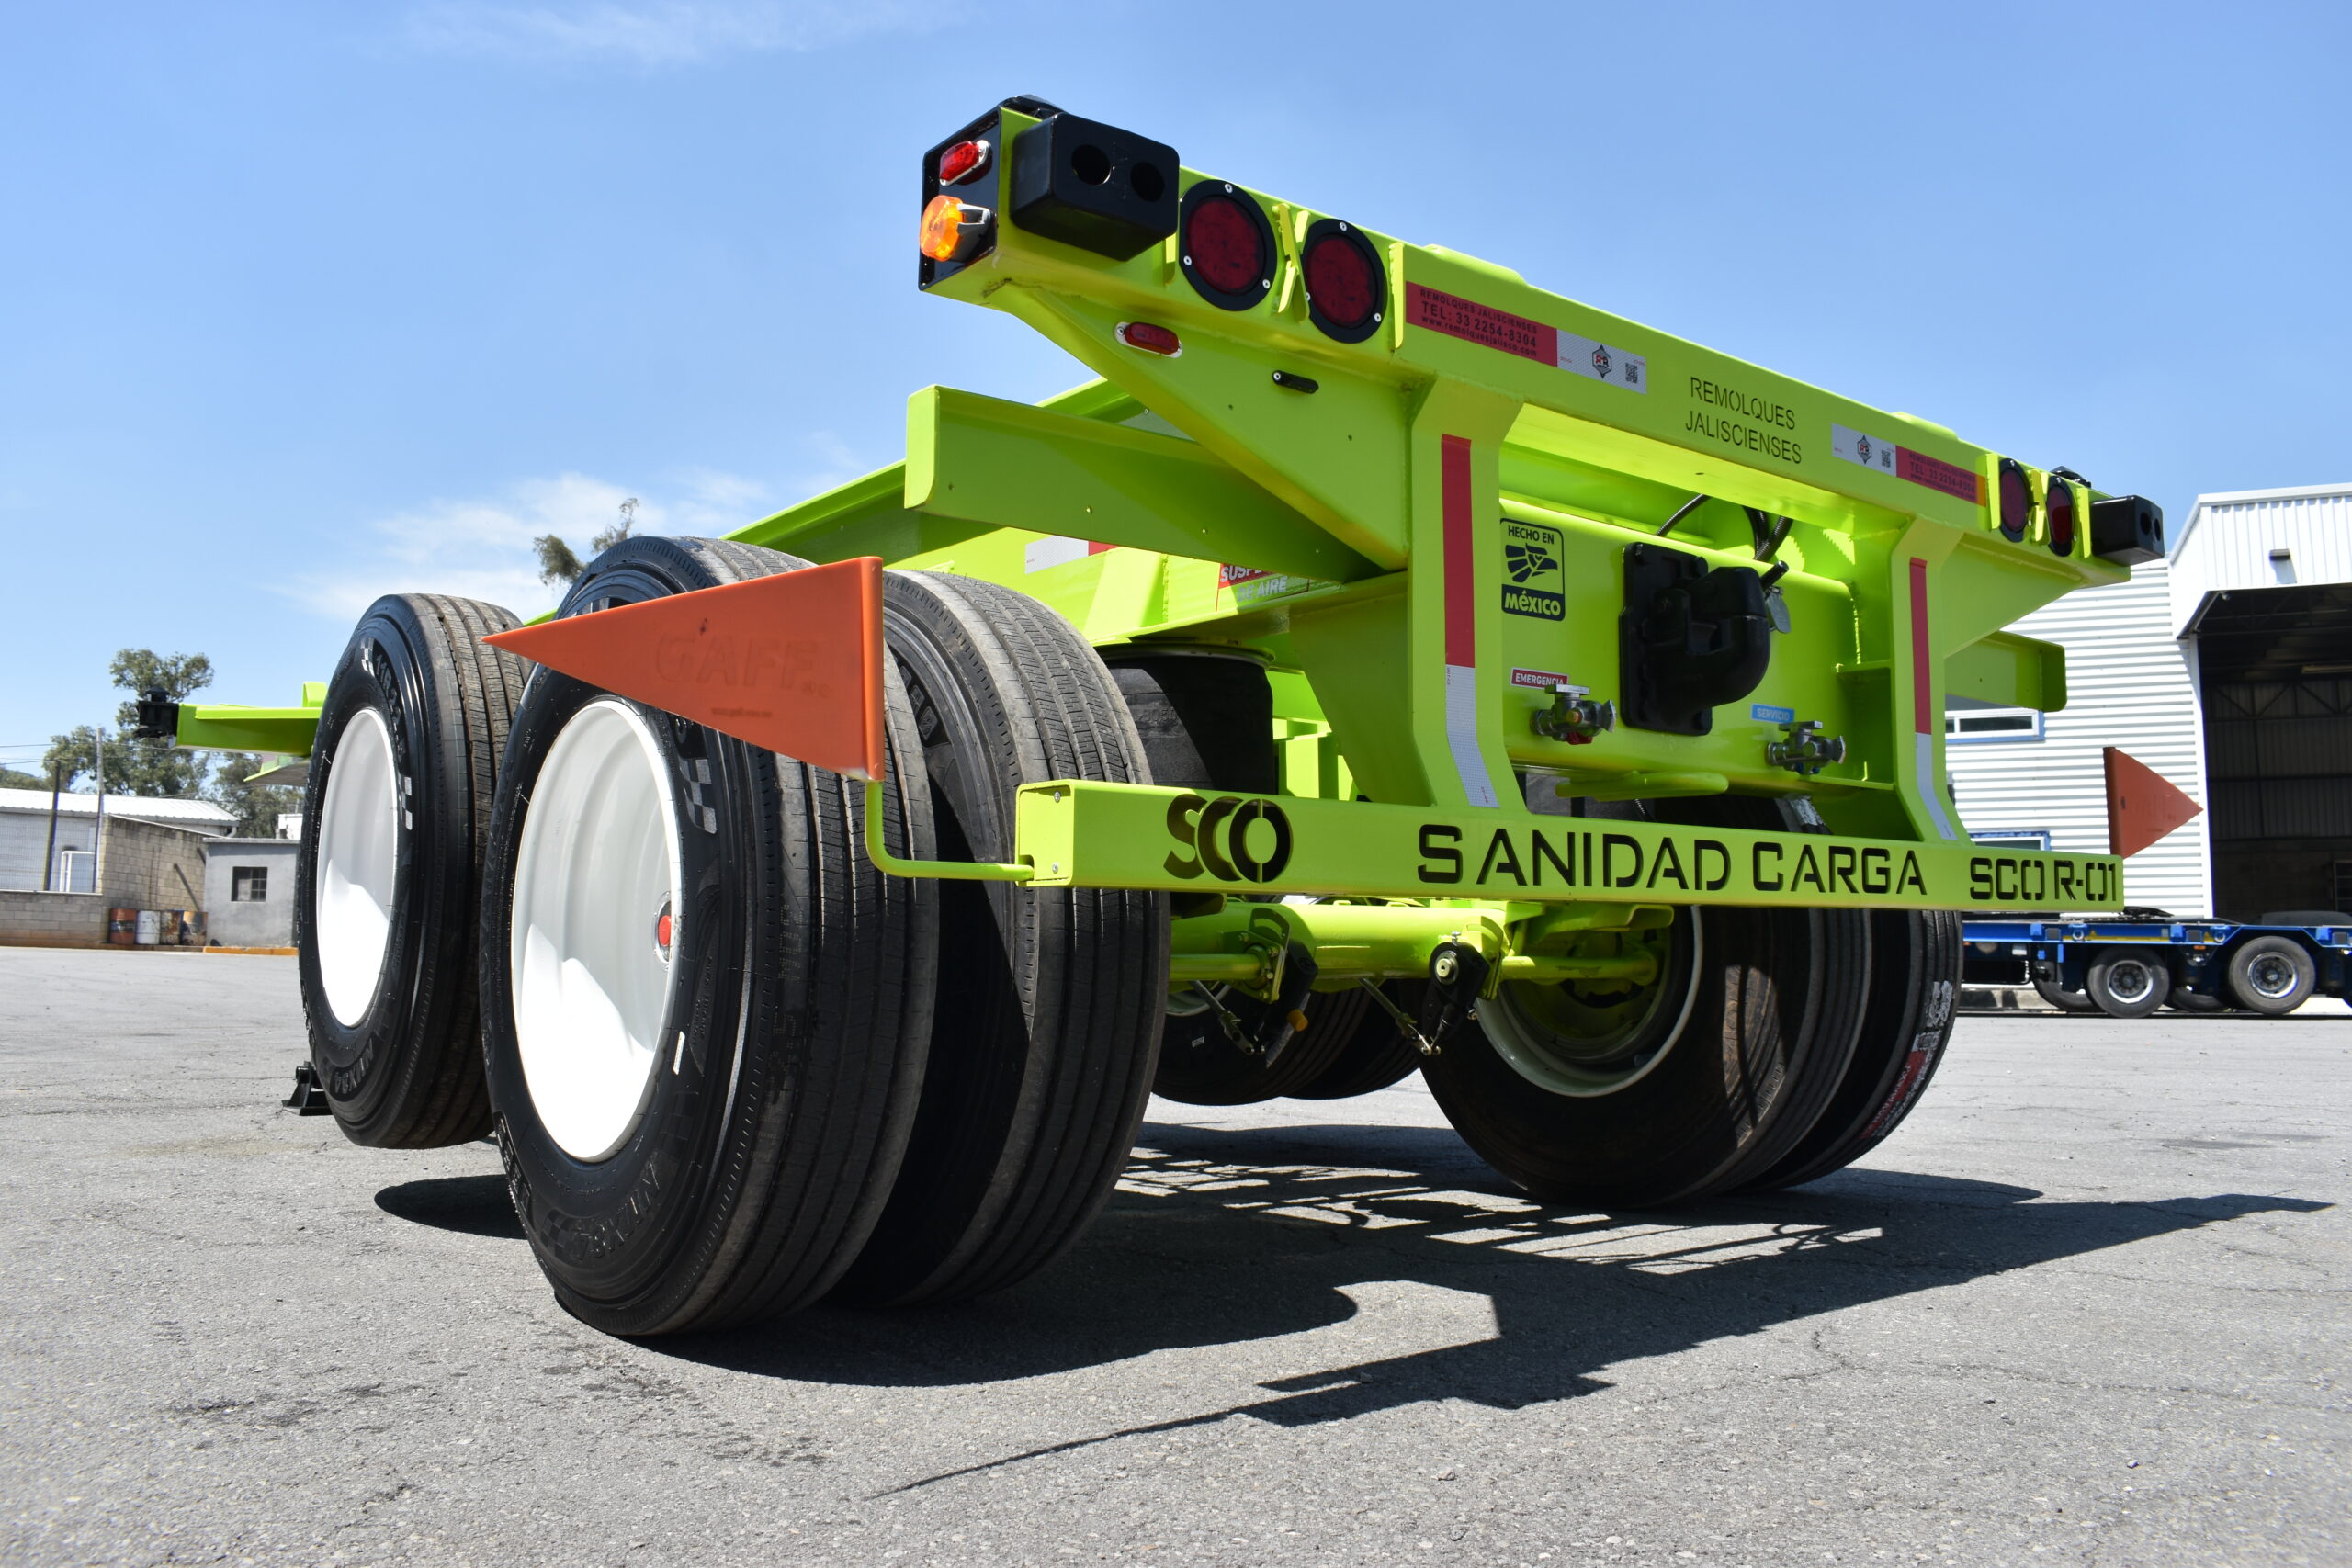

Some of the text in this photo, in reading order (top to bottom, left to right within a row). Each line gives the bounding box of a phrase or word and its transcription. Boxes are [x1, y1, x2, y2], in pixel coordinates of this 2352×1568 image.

[1420, 288, 1537, 333] REMOLQUES JALISCIENSES
[1421, 301, 1536, 347] TEL: 33 2254-8304
[1690, 377, 1795, 430] REMOLQUES
[1685, 410, 1802, 464] JALISCIENSES
[1508, 525, 1555, 545] HECHO EN
[1257, 575, 1288, 597] AIRE
[1756, 707, 1790, 721] SERVICIO
[1163, 794, 1294, 884] SCO
[1418, 824, 1731, 891] SANIDAD
[1753, 840, 1927, 896] CARGA
